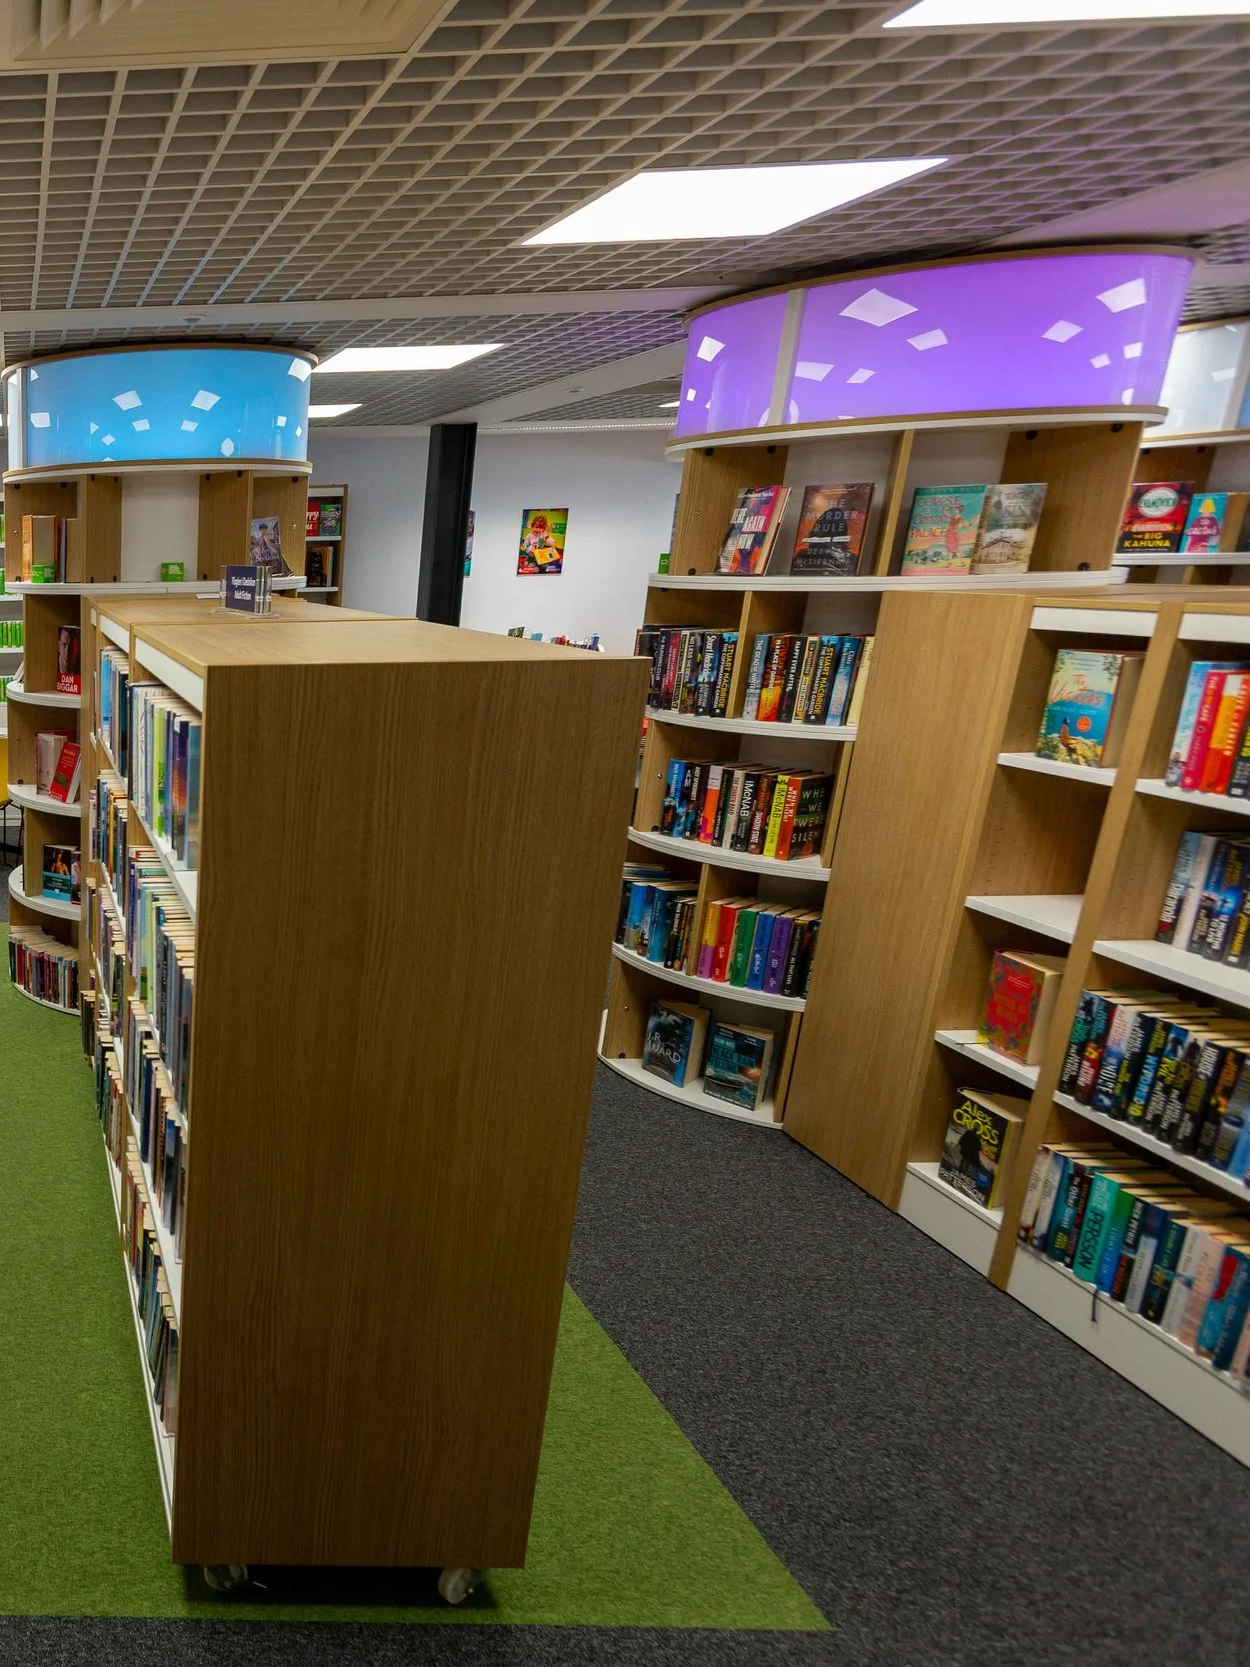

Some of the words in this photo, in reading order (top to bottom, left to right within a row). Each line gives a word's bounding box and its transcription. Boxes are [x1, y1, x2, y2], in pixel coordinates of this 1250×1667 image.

[742, 515, 766, 533] AGAIN
[806, 510, 859, 520] MURDER
[813, 522, 845, 532] RULE
[1123, 540, 1171, 548] KAHUNA
[689, 636, 695, 644] NO
[704, 635, 716, 652] Stuart
[792, 641, 801, 659] HAPPY
[699, 652, 713, 683] MacBride
[724, 644, 734, 671] STUART
[789, 659, 797, 673] EVER
[822, 647, 833, 675] STUART
[56, 682, 79, 693] BIGGAR
[61, 674, 74, 684] DAN
[717, 672, 728, 708] MACBRIDE
[749, 672, 757, 692] WINTER
[1072, 674, 1086, 685] The
[813, 677, 827, 715] MACBRIDE
[1049, 680, 1105, 706] Visitors
[808, 802, 823, 812] WE
[752, 810, 762, 830] SHADOW
[750, 830, 759, 843] STATE
[1159, 883, 1186, 923] Paranoia
[1132, 1028, 1144, 1054] JAMES
[649, 1043, 681, 1063] WARD
[1196, 1043, 1218, 1079] HOUSE
[1095, 1059, 1118, 1096] NOISE
[1139, 1052, 1158, 1087] NYPD
[961, 1100, 993, 1125] Alex
[953, 1108, 999, 1145] CROSS
[1065, 1184, 1079, 1208] Other
[1059, 1205, 1073, 1229] Guest
[1130, 1199, 1144, 1220] NICK
[1075, 1208, 1106, 1272] PERSSON
[1123, 1217, 1139, 1245] PETRIE
